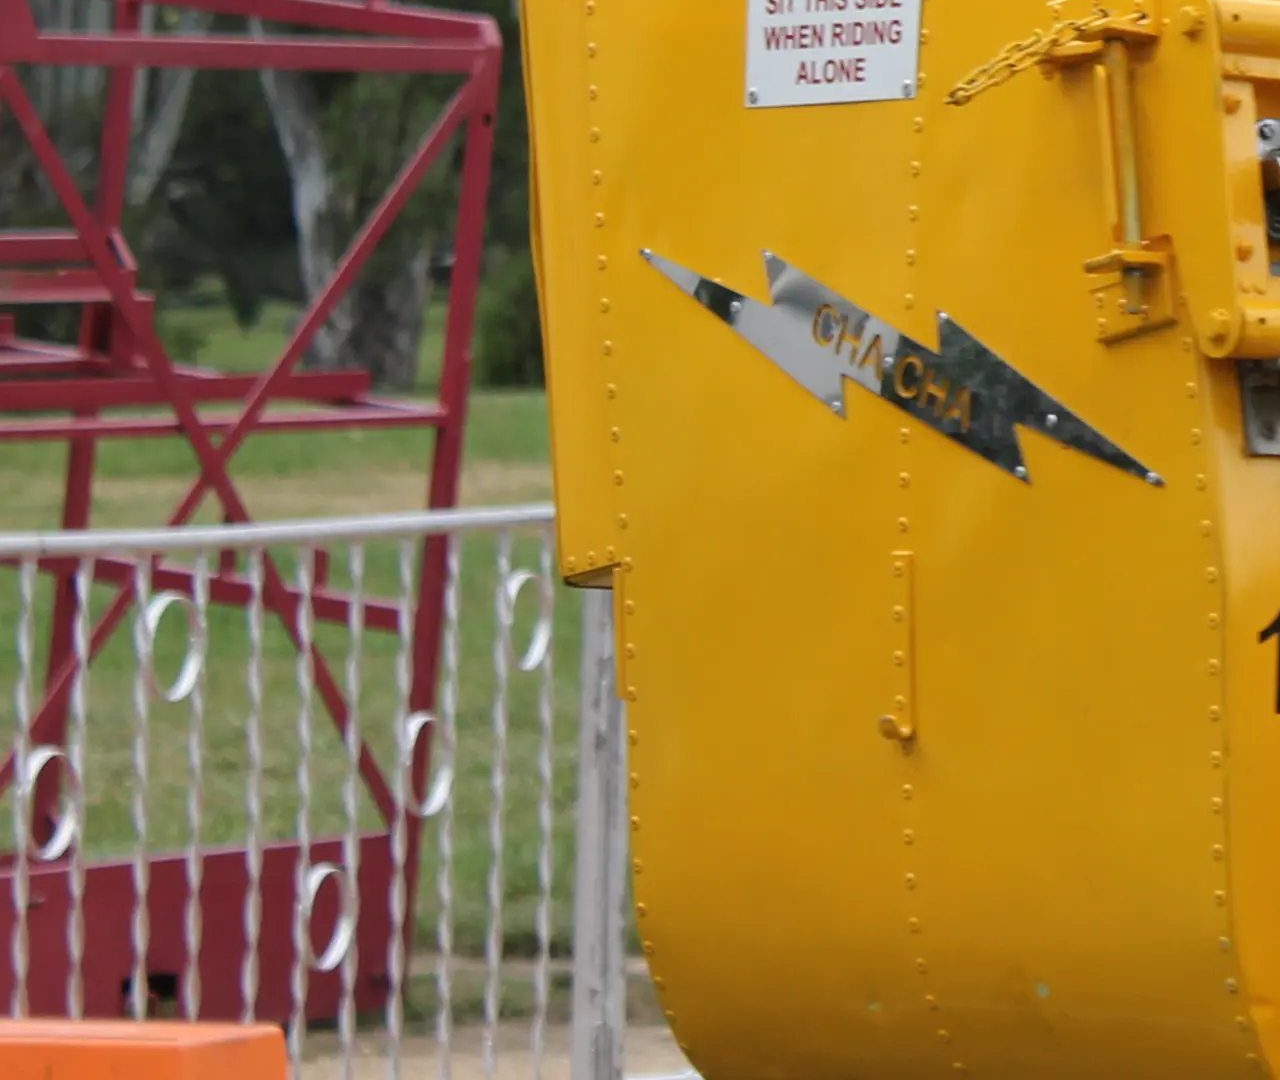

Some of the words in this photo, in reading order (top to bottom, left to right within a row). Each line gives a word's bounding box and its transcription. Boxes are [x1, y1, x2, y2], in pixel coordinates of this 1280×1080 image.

[763, 23, 824, 51] WHEN
[830, 19, 902, 47] RIDING
[794, 57, 866, 85] ALONE
